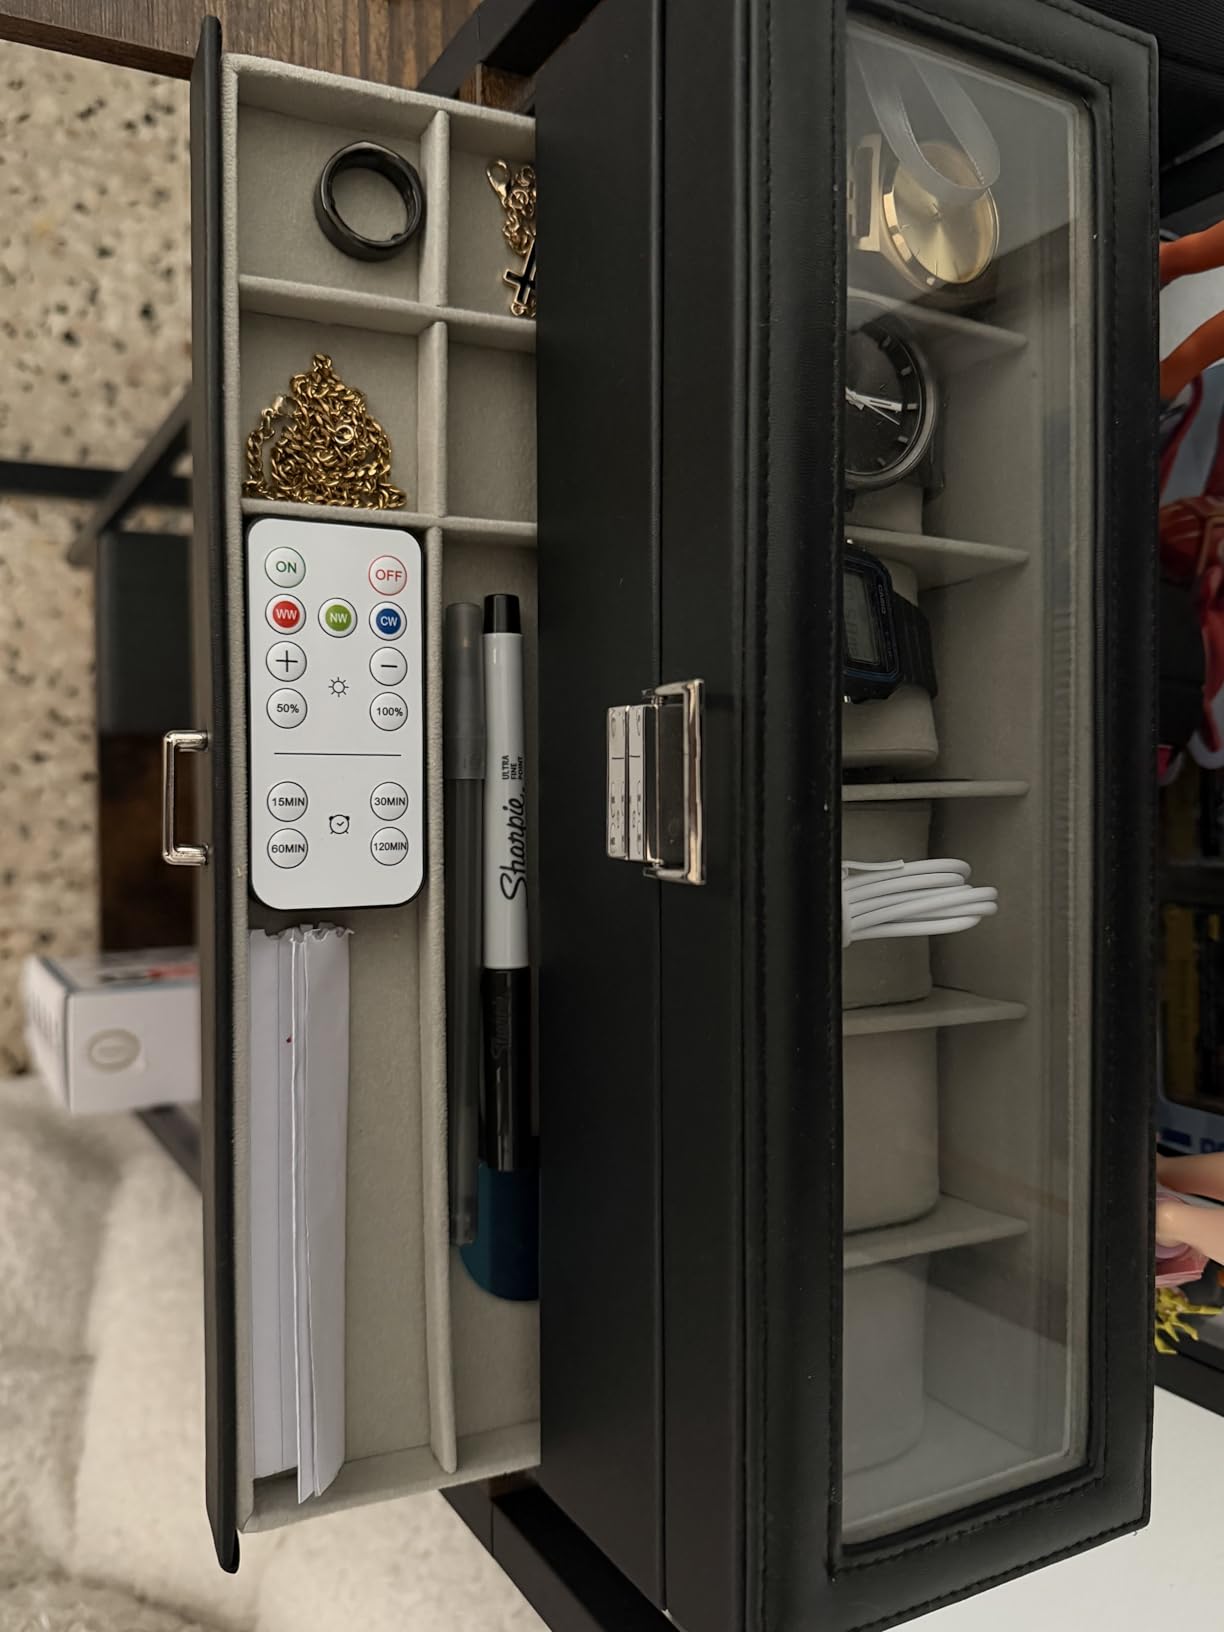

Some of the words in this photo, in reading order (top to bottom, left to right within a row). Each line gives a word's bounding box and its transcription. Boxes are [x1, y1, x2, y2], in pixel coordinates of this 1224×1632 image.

[275, 560, 297, 574] ON
[375, 569, 403, 582] OFF
[276, 608, 298, 621] WW
[329, 613, 349, 624] NW
[380, 615, 398, 627] CW
[276, 703, 299, 714] 50%
[376, 706, 404, 717] 100%
[502, 755, 510, 780] ULTRA
[271, 797, 305, 807] 15MIN
[374, 797, 406, 806] 30MIN
[271, 843, 305, 854] 60MIN
[373, 841, 407, 851] 120MIN
